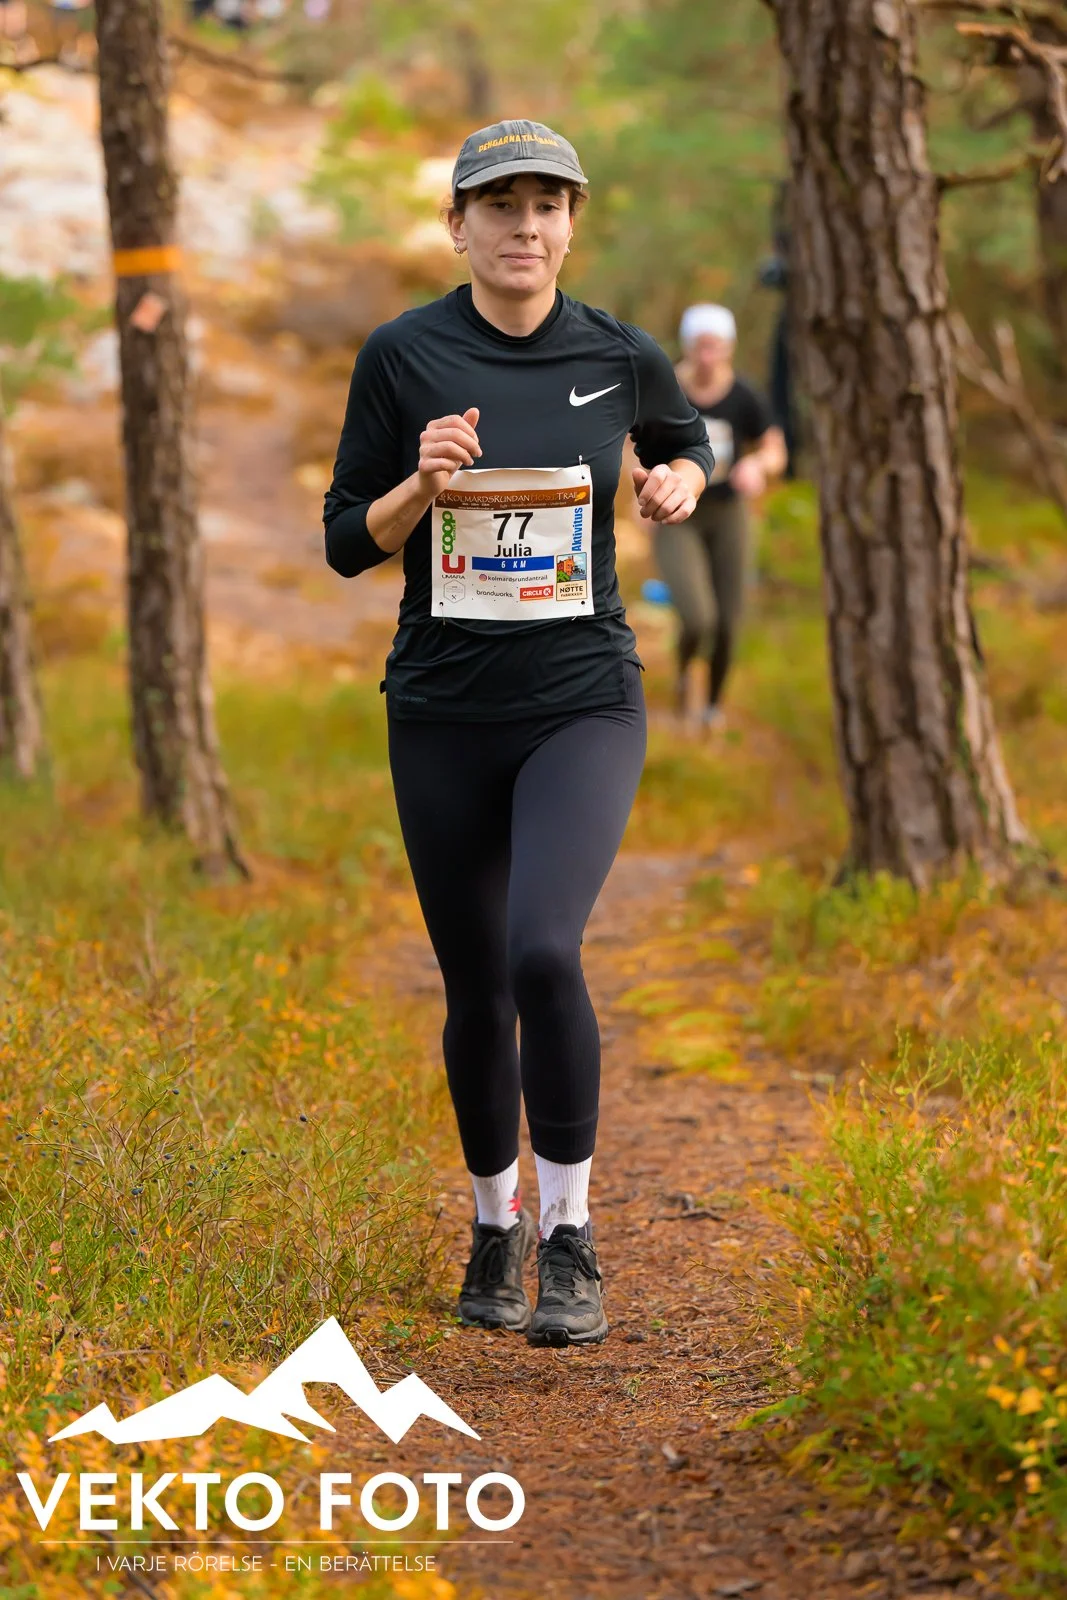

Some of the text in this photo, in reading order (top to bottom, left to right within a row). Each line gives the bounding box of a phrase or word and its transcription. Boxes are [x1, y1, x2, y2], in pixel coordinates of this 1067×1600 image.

[478, 134, 520, 153] PENGARNA
[442, 511, 456, 554] coop
[493, 512, 534, 541] 77
[571, 507, 583, 552] Aktivitus
[494, 544, 532, 558] Julia
[501, 560, 506, 569] 6
